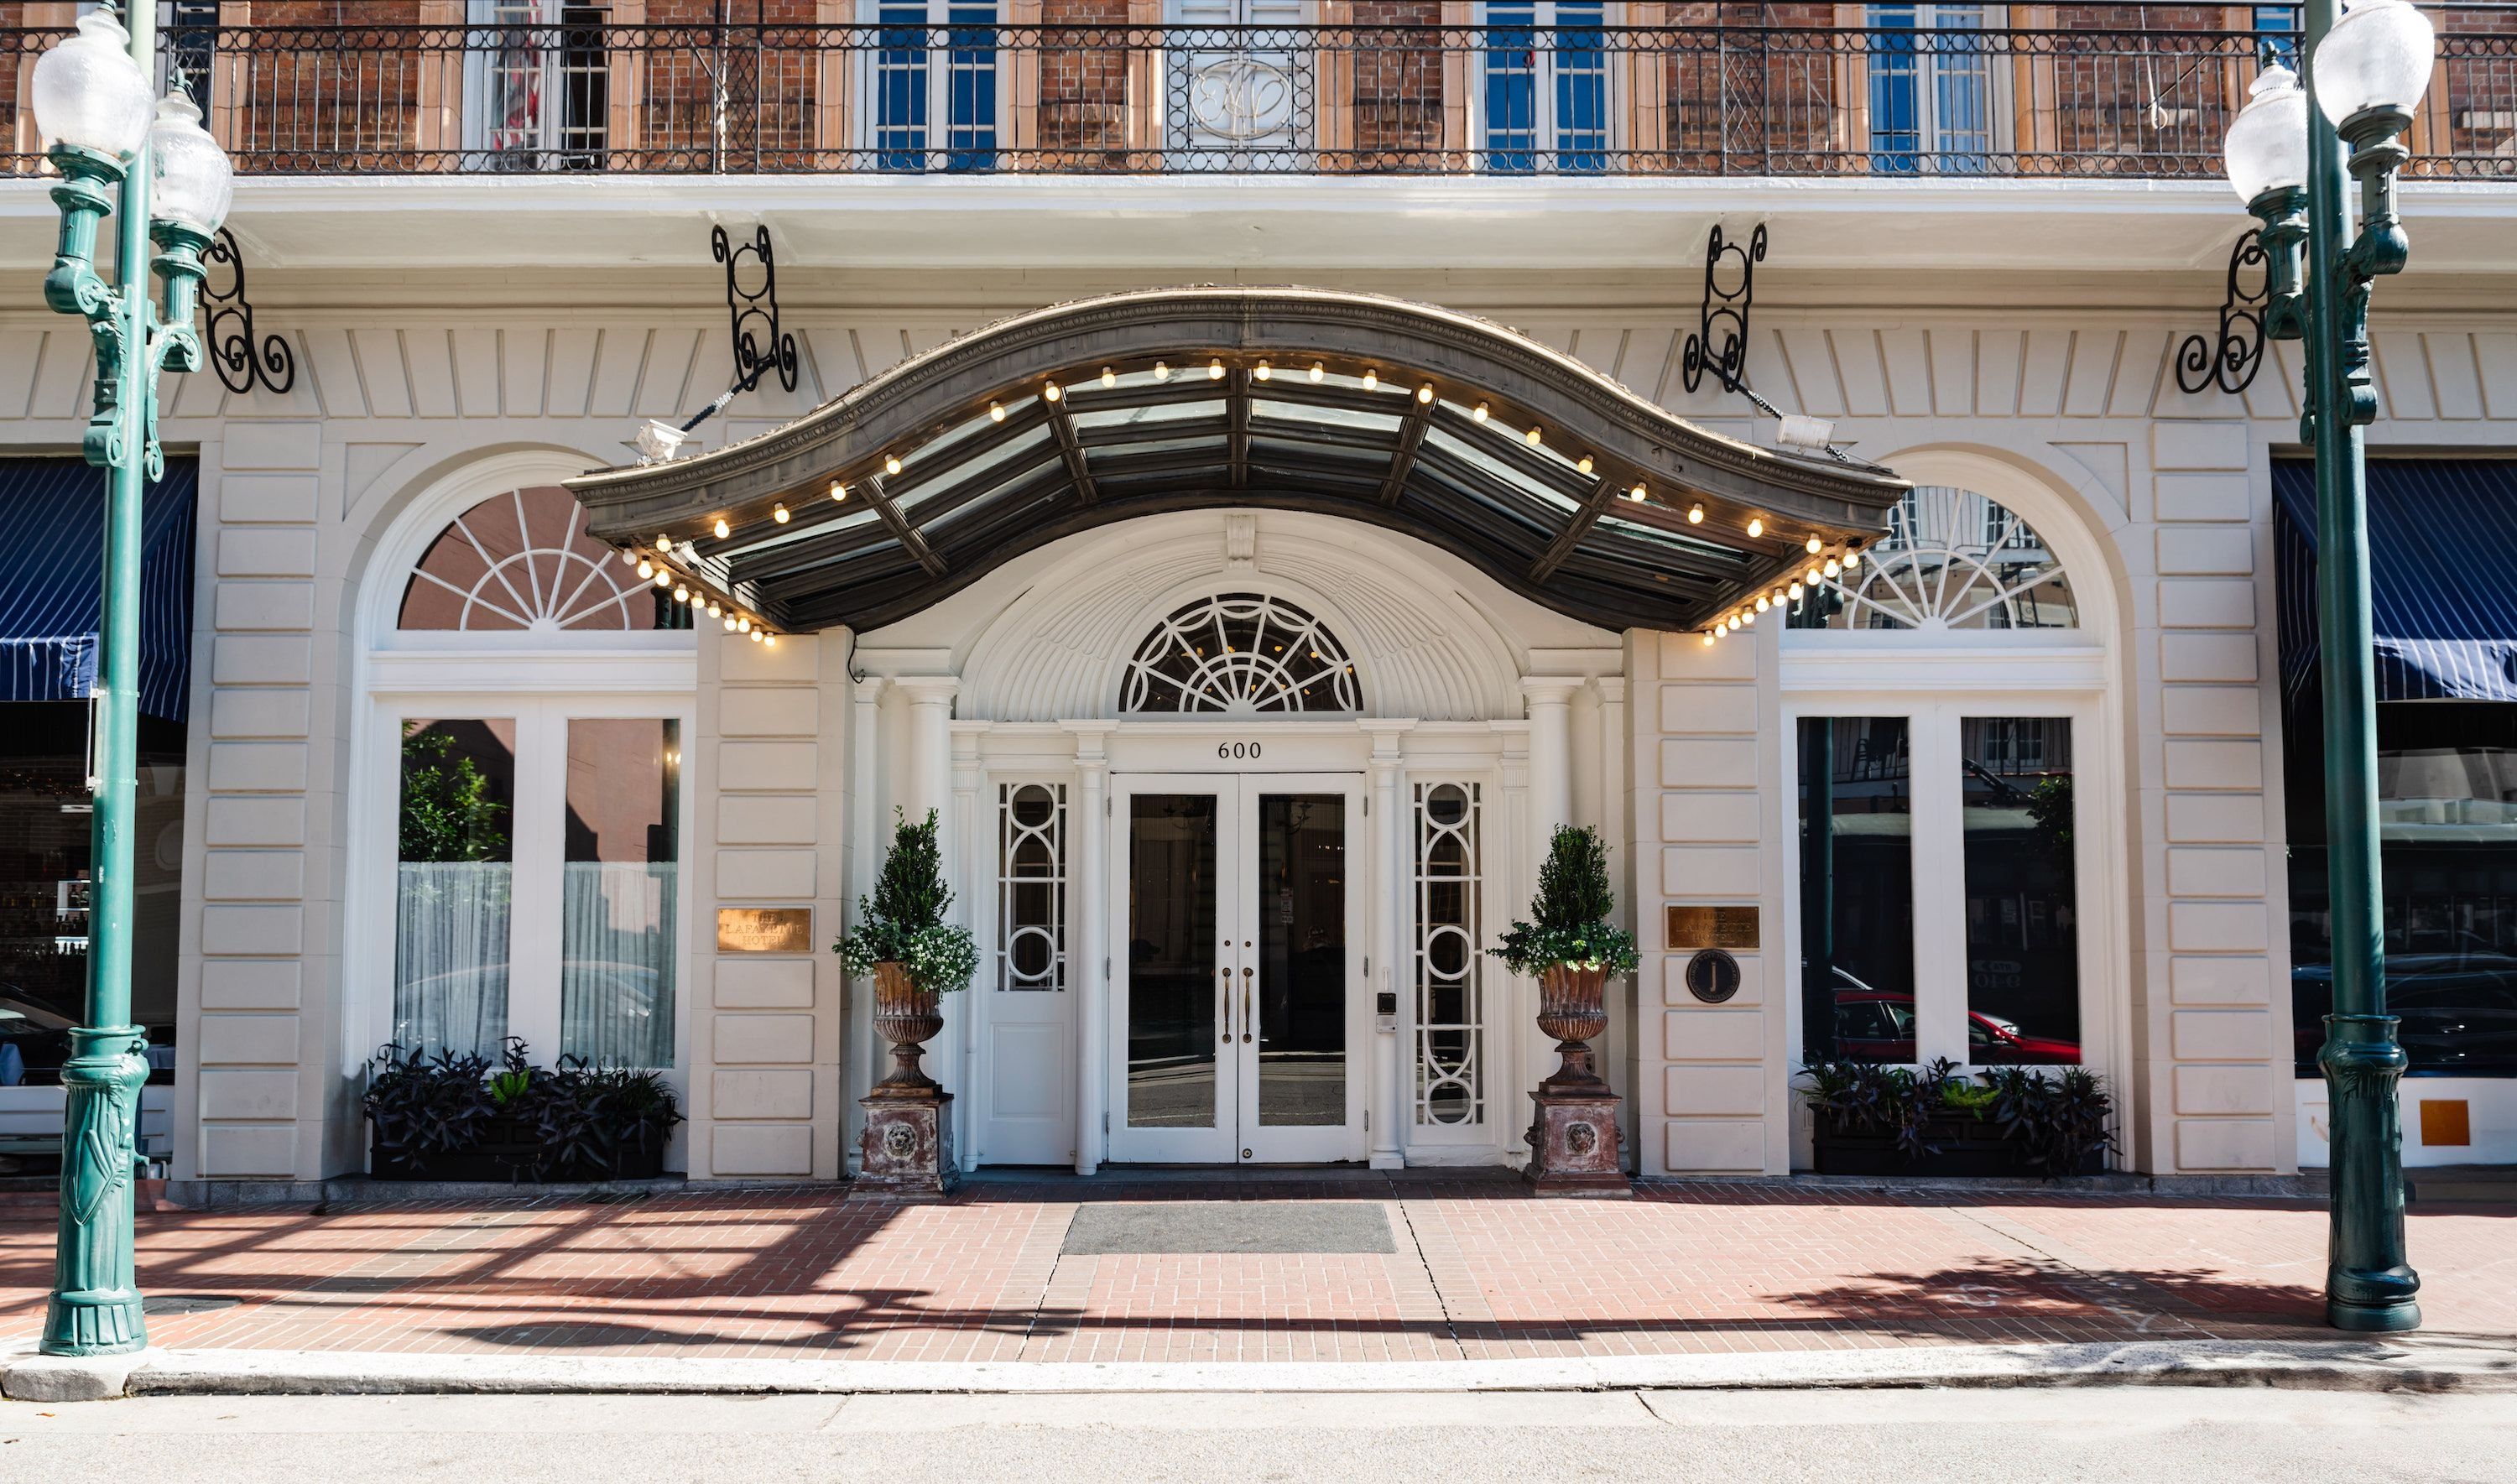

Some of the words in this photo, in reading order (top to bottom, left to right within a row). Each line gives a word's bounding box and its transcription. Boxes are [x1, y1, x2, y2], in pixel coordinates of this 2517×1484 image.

[1218, 742, 1261, 759] 600
[752, 914, 778, 924] THE
[743, 935, 785, 946] HOTEL
